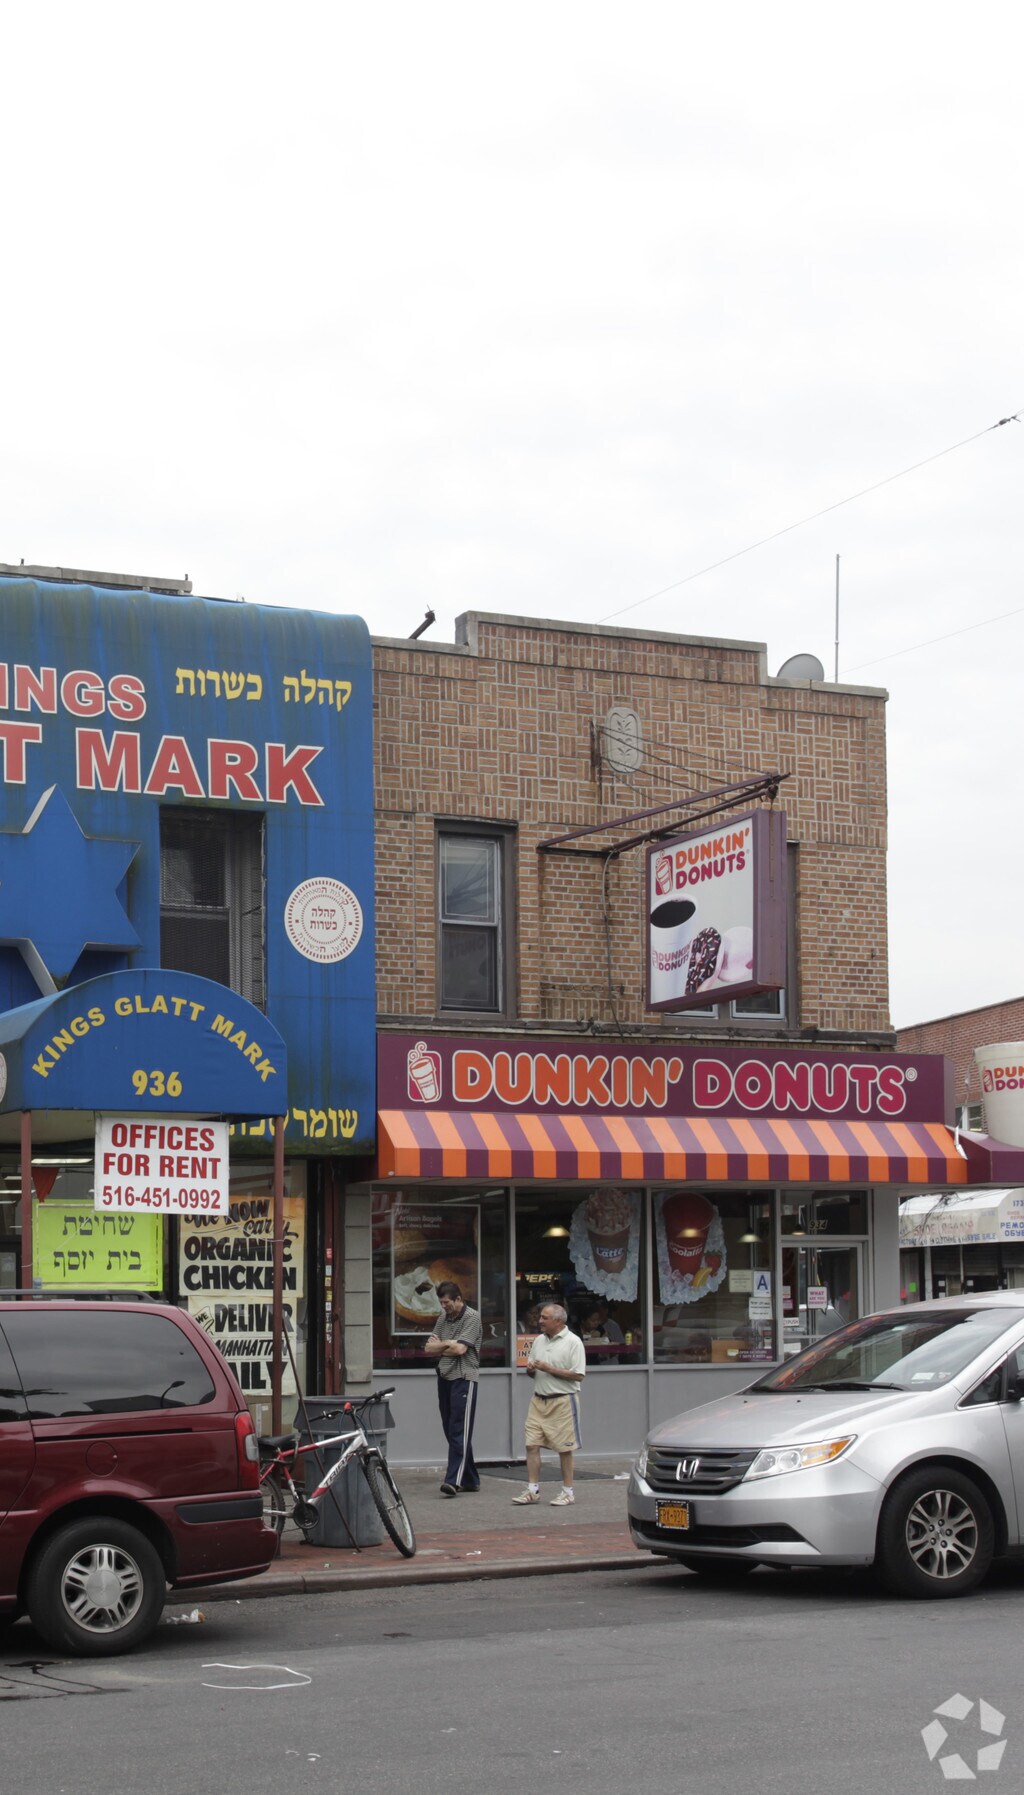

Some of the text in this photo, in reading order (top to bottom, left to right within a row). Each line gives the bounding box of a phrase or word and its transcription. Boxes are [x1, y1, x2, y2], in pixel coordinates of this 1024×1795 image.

[175, 667, 353, 712] קהלה כשרות
[75, 727, 326, 807] MARK
[309, 920, 338, 931] כשרות
[311, 906, 336, 919] קהלה
[31, 1006, 106, 1078] KINGS
[114, 994, 205, 1022] GLATT
[210, 1013, 277, 1082] MARK
[132, 1069, 183, 1097] 936
[452, 1049, 684, 1109] DUNKIN'
[292, 1107, 359, 1138] שומר
[111, 1123, 216, 1152] OFFICES
[103, 1152, 222, 1180] FOR RENT
[102, 1185, 221, 1210] 516-451-0992
[62, 1215, 135, 1236] שחיטת
[242, 1218, 299, 1240] cary
[809, 1220, 826, 1230] 934
[53, 1250, 142, 1278] בית יוסף
[756, 1274, 769, 1291] A
